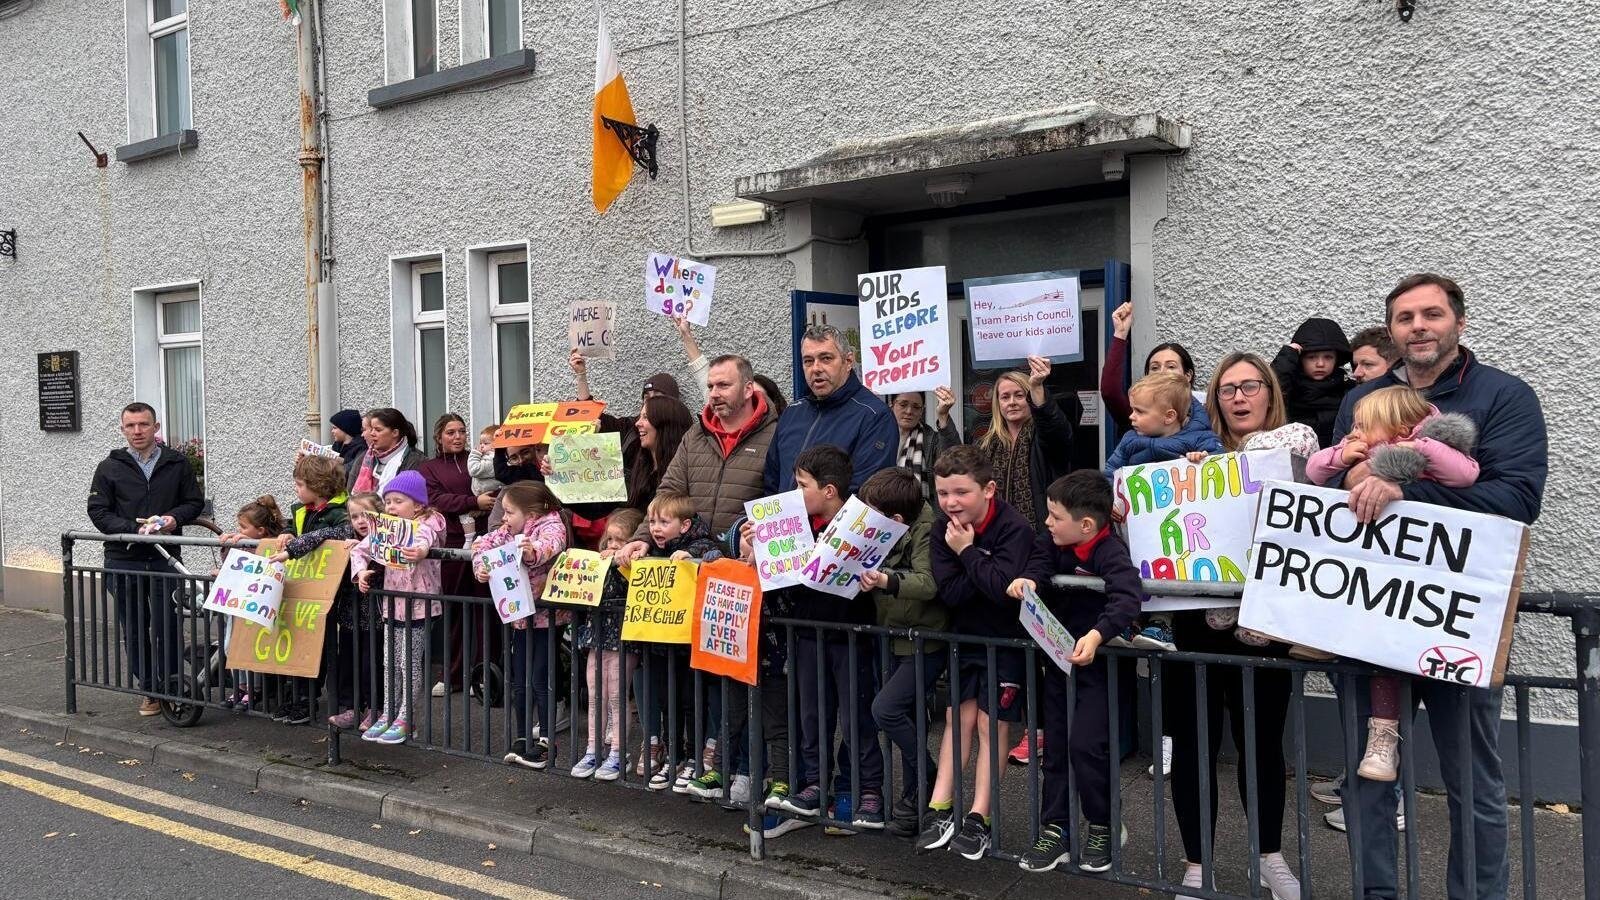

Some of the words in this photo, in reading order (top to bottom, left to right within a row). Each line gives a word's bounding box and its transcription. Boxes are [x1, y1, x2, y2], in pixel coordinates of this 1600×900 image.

[653, 256, 705, 285] Where
[654, 278, 675, 294] do
[682, 284, 700, 299] we
[858, 273, 902, 302] OUR
[572, 306, 600, 323] WHERE
[661, 299, 694, 317] go?
[875, 291, 921, 319] KIDS
[973, 300, 996, 311] Hey,
[871, 304, 939, 339] BEFORE
[975, 316, 1002, 326] Tuam
[1004, 312, 1034, 324] Parish
[1036, 308, 1074, 321] Council,
[577, 330, 595, 347] WE
[1006, 330, 1022, 338] our
[1025, 326, 1044, 337] kids
[870, 339, 924, 366] Your
[864, 355, 940, 388] PROFITS
[504, 428, 533, 440] WE
[554, 443, 602, 464] Save
[583, 464, 624, 483] Crech
[751, 499, 783, 521] OUR
[755, 515, 804, 544] CRECHE
[849, 507, 892, 544] have
[1159, 508, 1211, 556] ÁR
[1266, 488, 1473, 574] BROKEN
[768, 535, 797, 557] OUR
[821, 525, 882, 569] Happily
[231, 556, 285, 584] Sábhai
[577, 573, 599, 585] your
[631, 565, 677, 589] SAVE
[801, 556, 862, 588] After
[248, 578, 273, 594] ár
[548, 584, 594, 602] Promise
[708, 581, 736, 598] PLEASE
[736, 587, 752, 602] LET
[1254, 541, 1481, 640] PROMISE
[212, 587, 277, 625] Naíonr
[635, 590, 672, 605] OUR
[706, 594, 717, 607] US
[717, 597, 735, 611] HAVE
[734, 601, 749, 614] OUR
[294, 601, 321, 631] WE
[703, 606, 747, 630] HAPPILY
[710, 623, 737, 642] EVER
[255, 627, 292, 664] GO
[706, 637, 740, 657] AFTER
